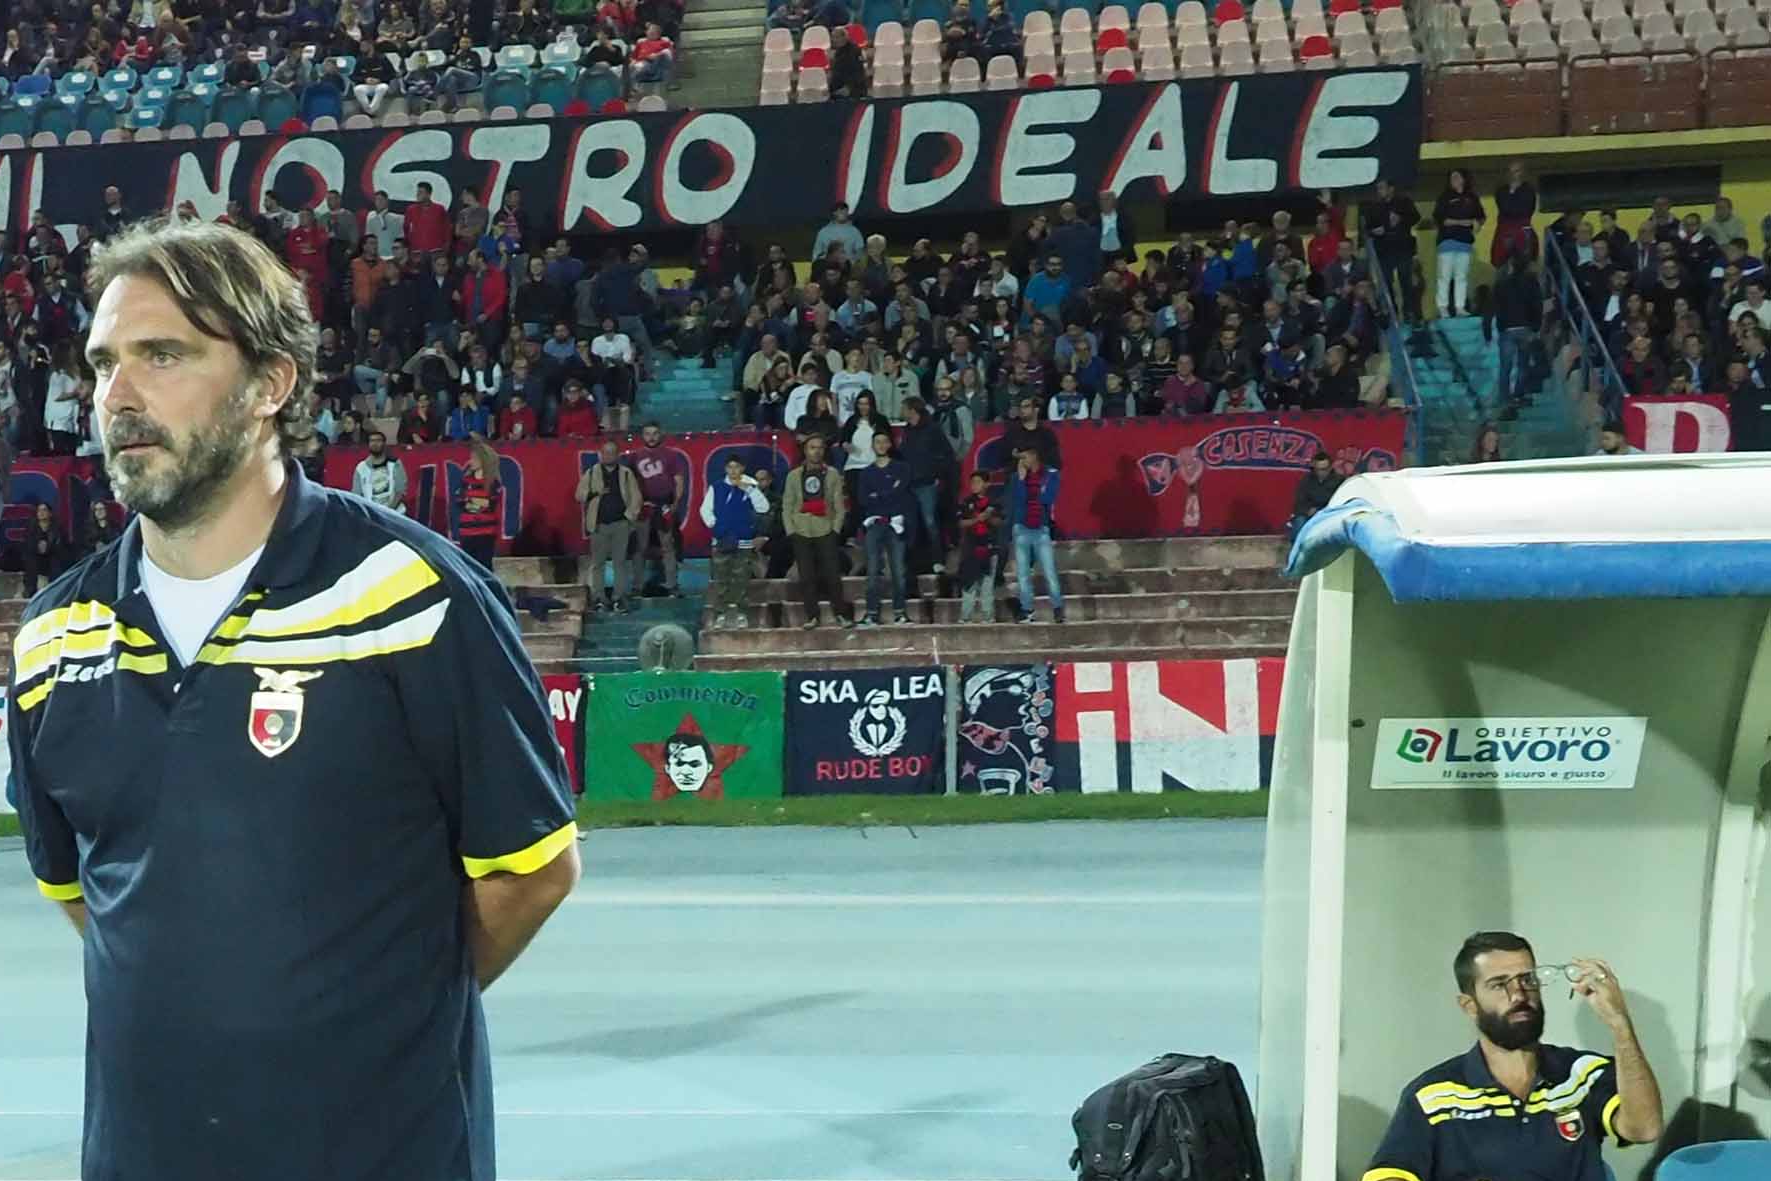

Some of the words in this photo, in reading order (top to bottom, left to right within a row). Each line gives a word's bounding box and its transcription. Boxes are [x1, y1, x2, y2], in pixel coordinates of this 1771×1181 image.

[168, 112, 758, 233] NOSTRO
[837, 70, 1412, 214] IDEALE
[799, 679, 859, 704] SKA
[1475, 726, 1612, 738] OBIETTIVO
[1445, 728, 1611, 763] Lavoro
[816, 757, 883, 781] RUDE
[1456, 769, 1499, 779] lavoro
[1504, 769, 1546, 779] sicuro
[1563, 769, 1606, 780] giusto
